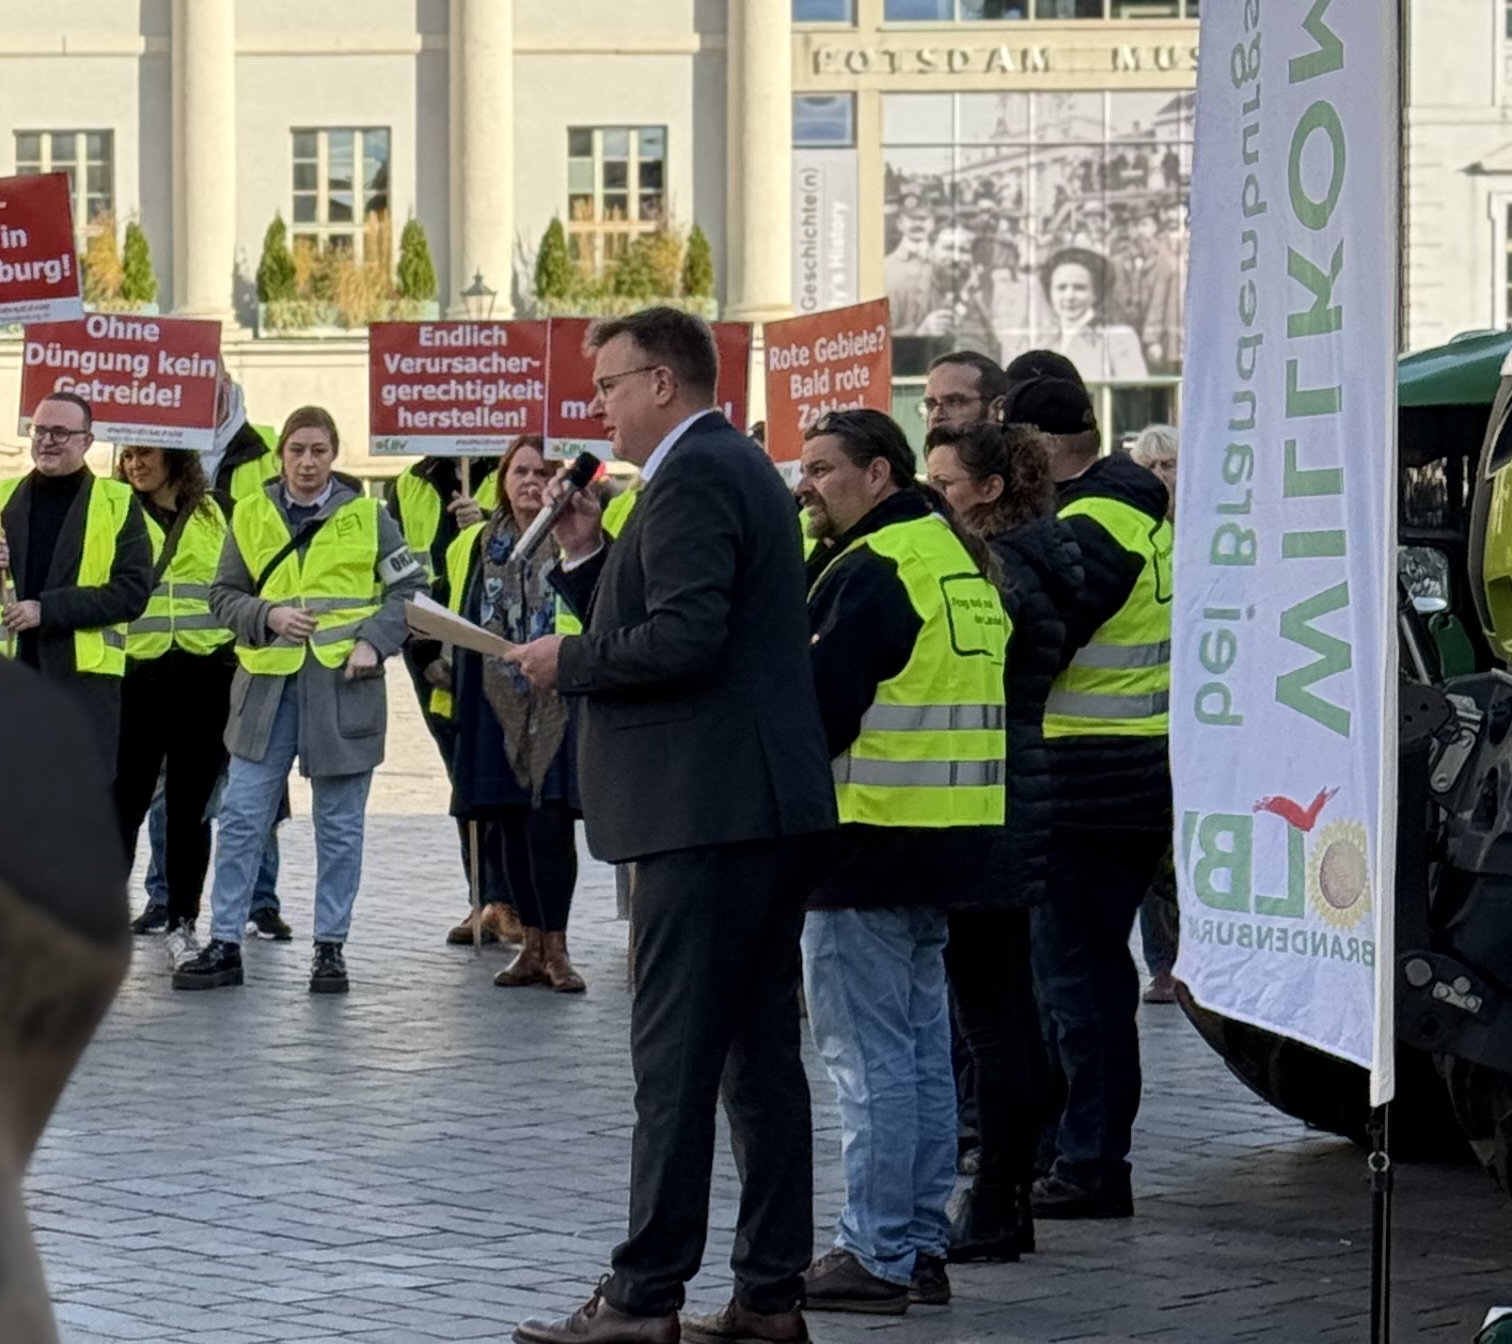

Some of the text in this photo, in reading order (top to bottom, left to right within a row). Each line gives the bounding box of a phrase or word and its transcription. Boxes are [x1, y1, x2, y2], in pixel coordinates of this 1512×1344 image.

[812, 45, 1052, 75] POTSDAM
[0, 226, 28, 249] in
[799, 167, 820, 311] Geschichte(n)
[86, 315, 160, 342] Ohne
[419, 325, 508, 347] Endlich
[26, 342, 216, 378] Düngung kein
[769, 324, 886, 371] Rote Gebiete?
[383, 352, 541, 374] Verursacher-
[54, 376, 182, 408] Getreide!
[381, 379, 544, 406] gerechtigkeit
[790, 363, 870, 400] Bald rote
[397, 406, 528, 428] herstellen!
[798, 394, 864, 431] Zah!
